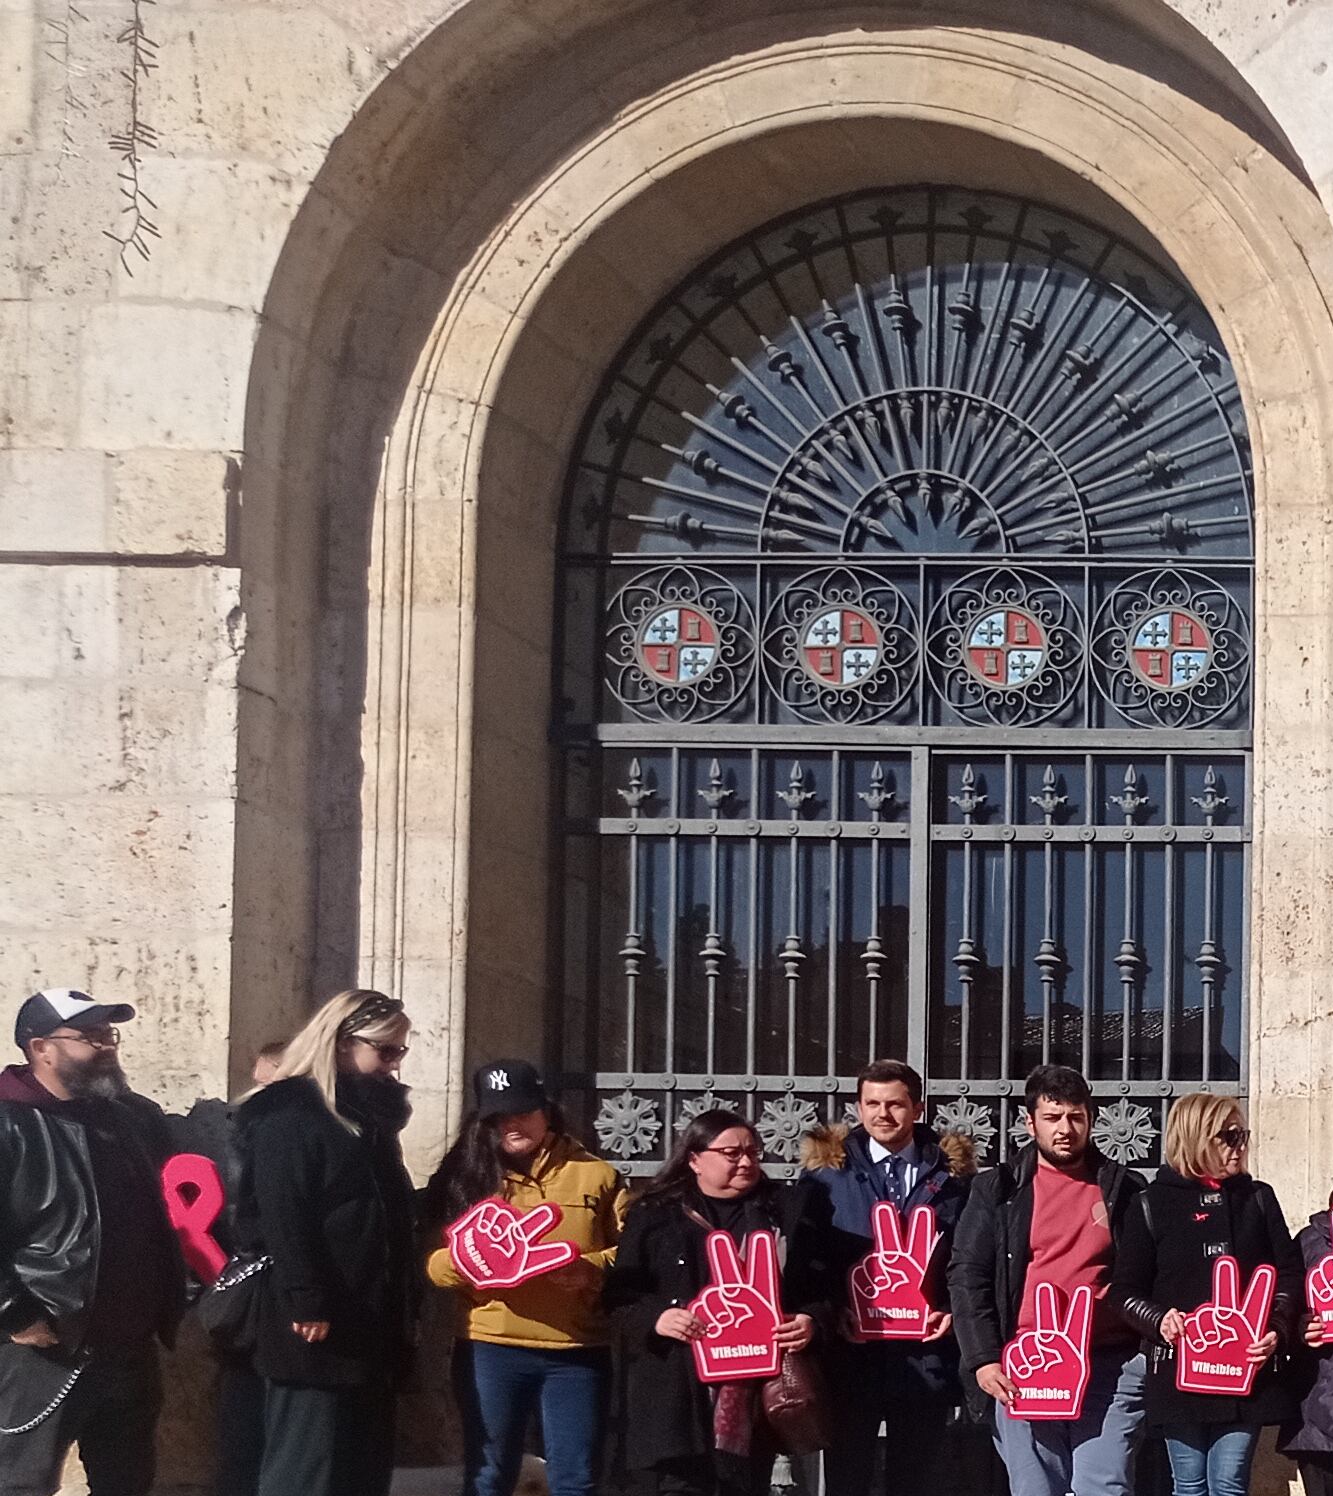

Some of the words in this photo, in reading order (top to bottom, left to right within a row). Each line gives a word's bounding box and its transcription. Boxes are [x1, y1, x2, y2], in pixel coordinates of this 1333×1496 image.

[489, 1069, 511, 1091] NY
[464, 1227, 494, 1277] VIHsibles
[867, 1306, 920, 1320] VIHsibles
[710, 1343, 768, 1360] VIHsibles
[1191, 1360, 1243, 1377] VIHsibles
[1018, 1387, 1071, 1400] VIHsibles
